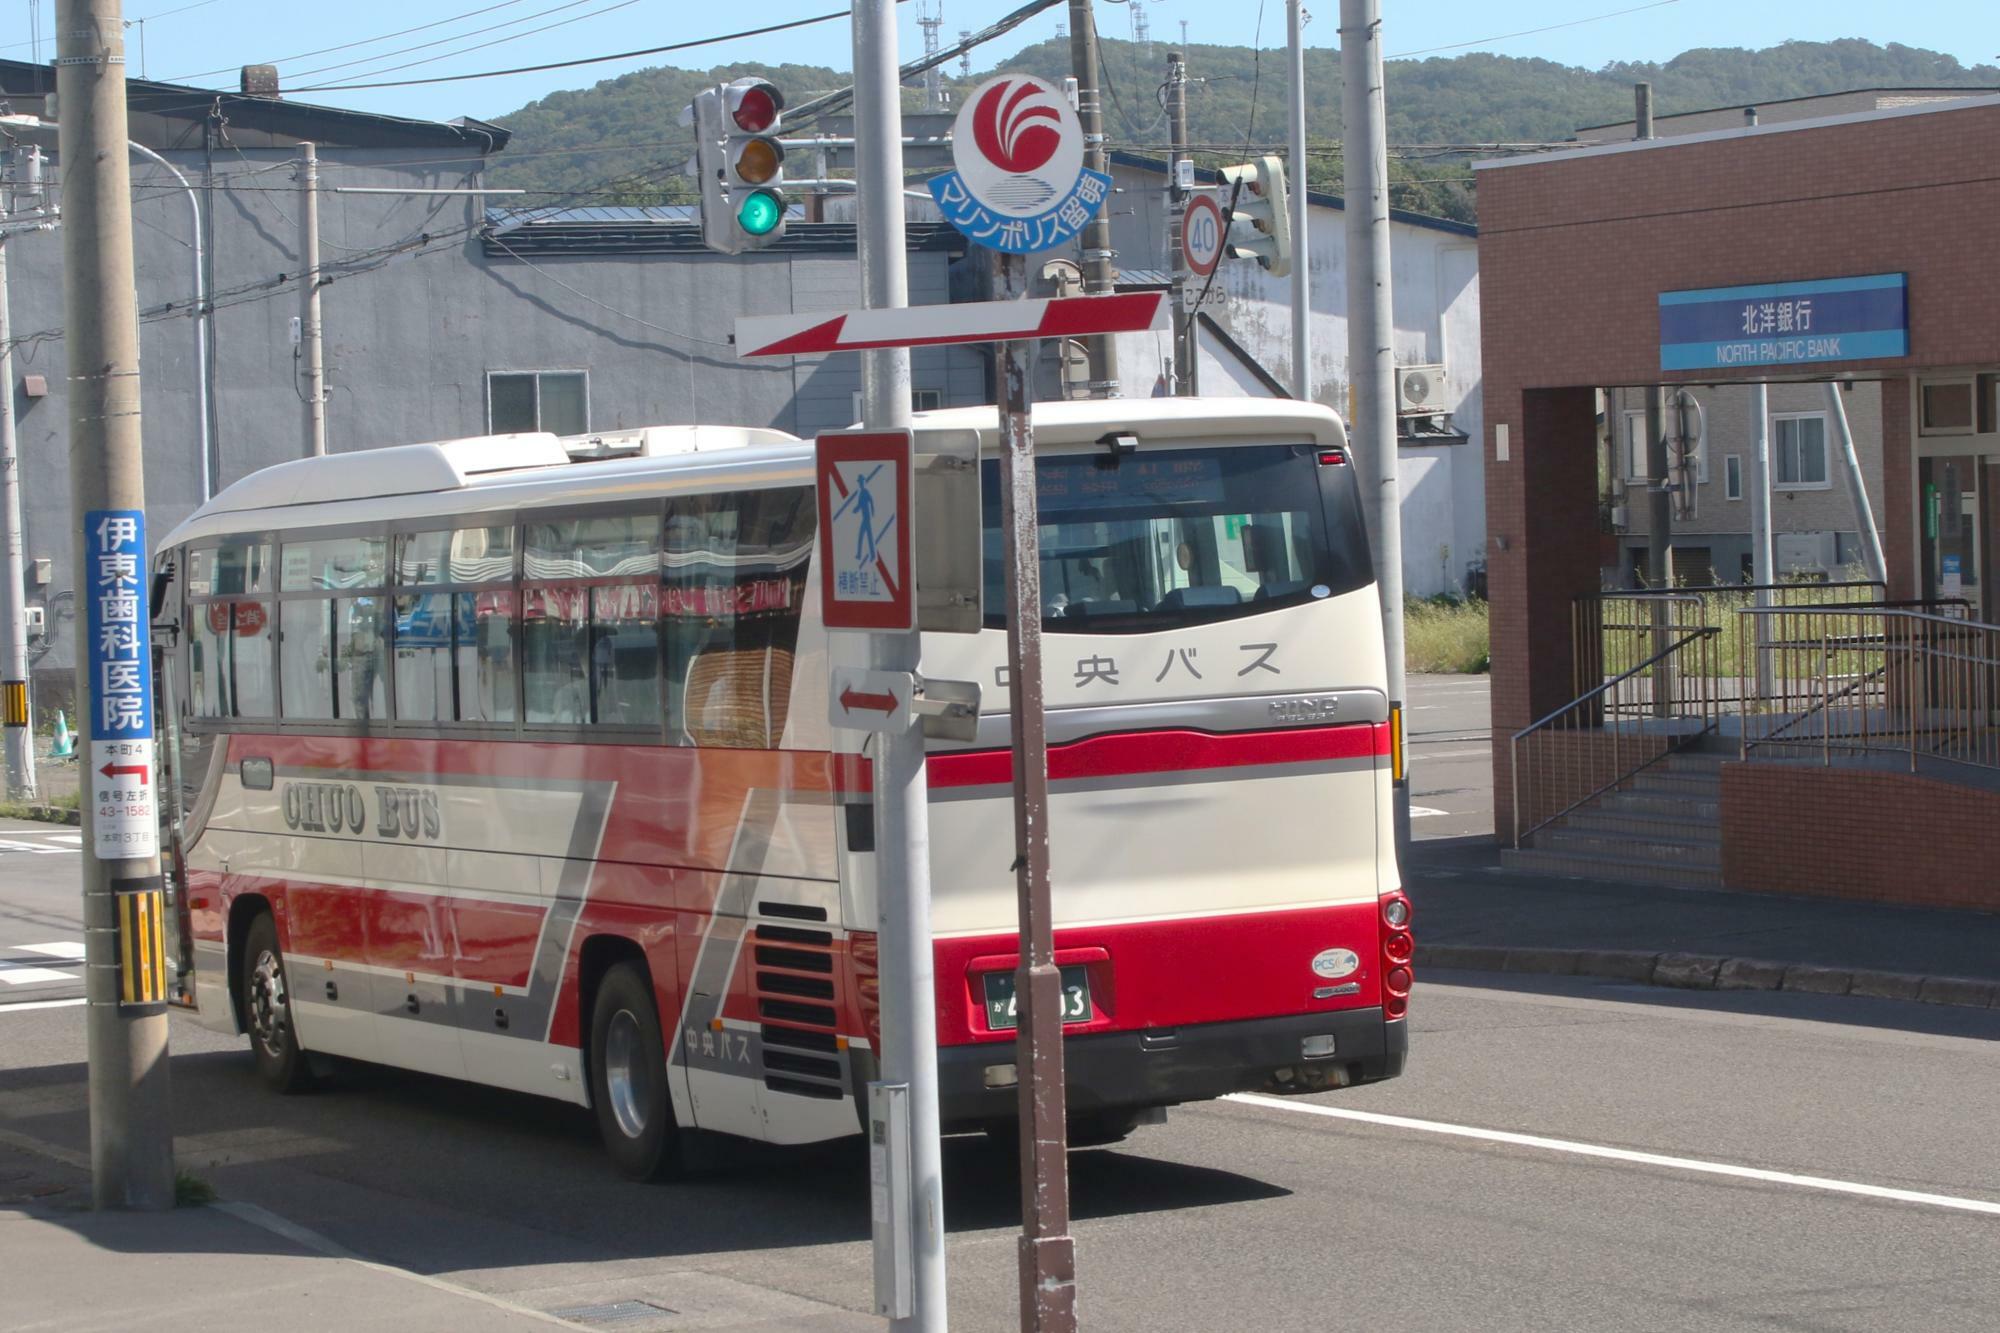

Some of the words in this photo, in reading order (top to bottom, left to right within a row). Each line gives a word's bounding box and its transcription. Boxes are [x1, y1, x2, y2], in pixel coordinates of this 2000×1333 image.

[940, 173, 1107, 250] マリンポリス留萌
[1191, 217, 1215, 252] 40
[1185, 286, 1226, 306] ここから
[1742, 300, 1813, 335] 北洋銀行
[1716, 343, 1756, 363] NORTH
[1760, 340, 1804, 361] PACIFIC
[1808, 337, 1841, 357] BANK
[96, 516, 144, 731] 伊東歯科医院
[105, 743, 144, 757] 本町4
[98, 790, 148, 802] 信号左折
[282, 781, 365, 835] CHUO
[376, 785, 441, 840] BUS
[686, 1029, 752, 1065] 中央バス
